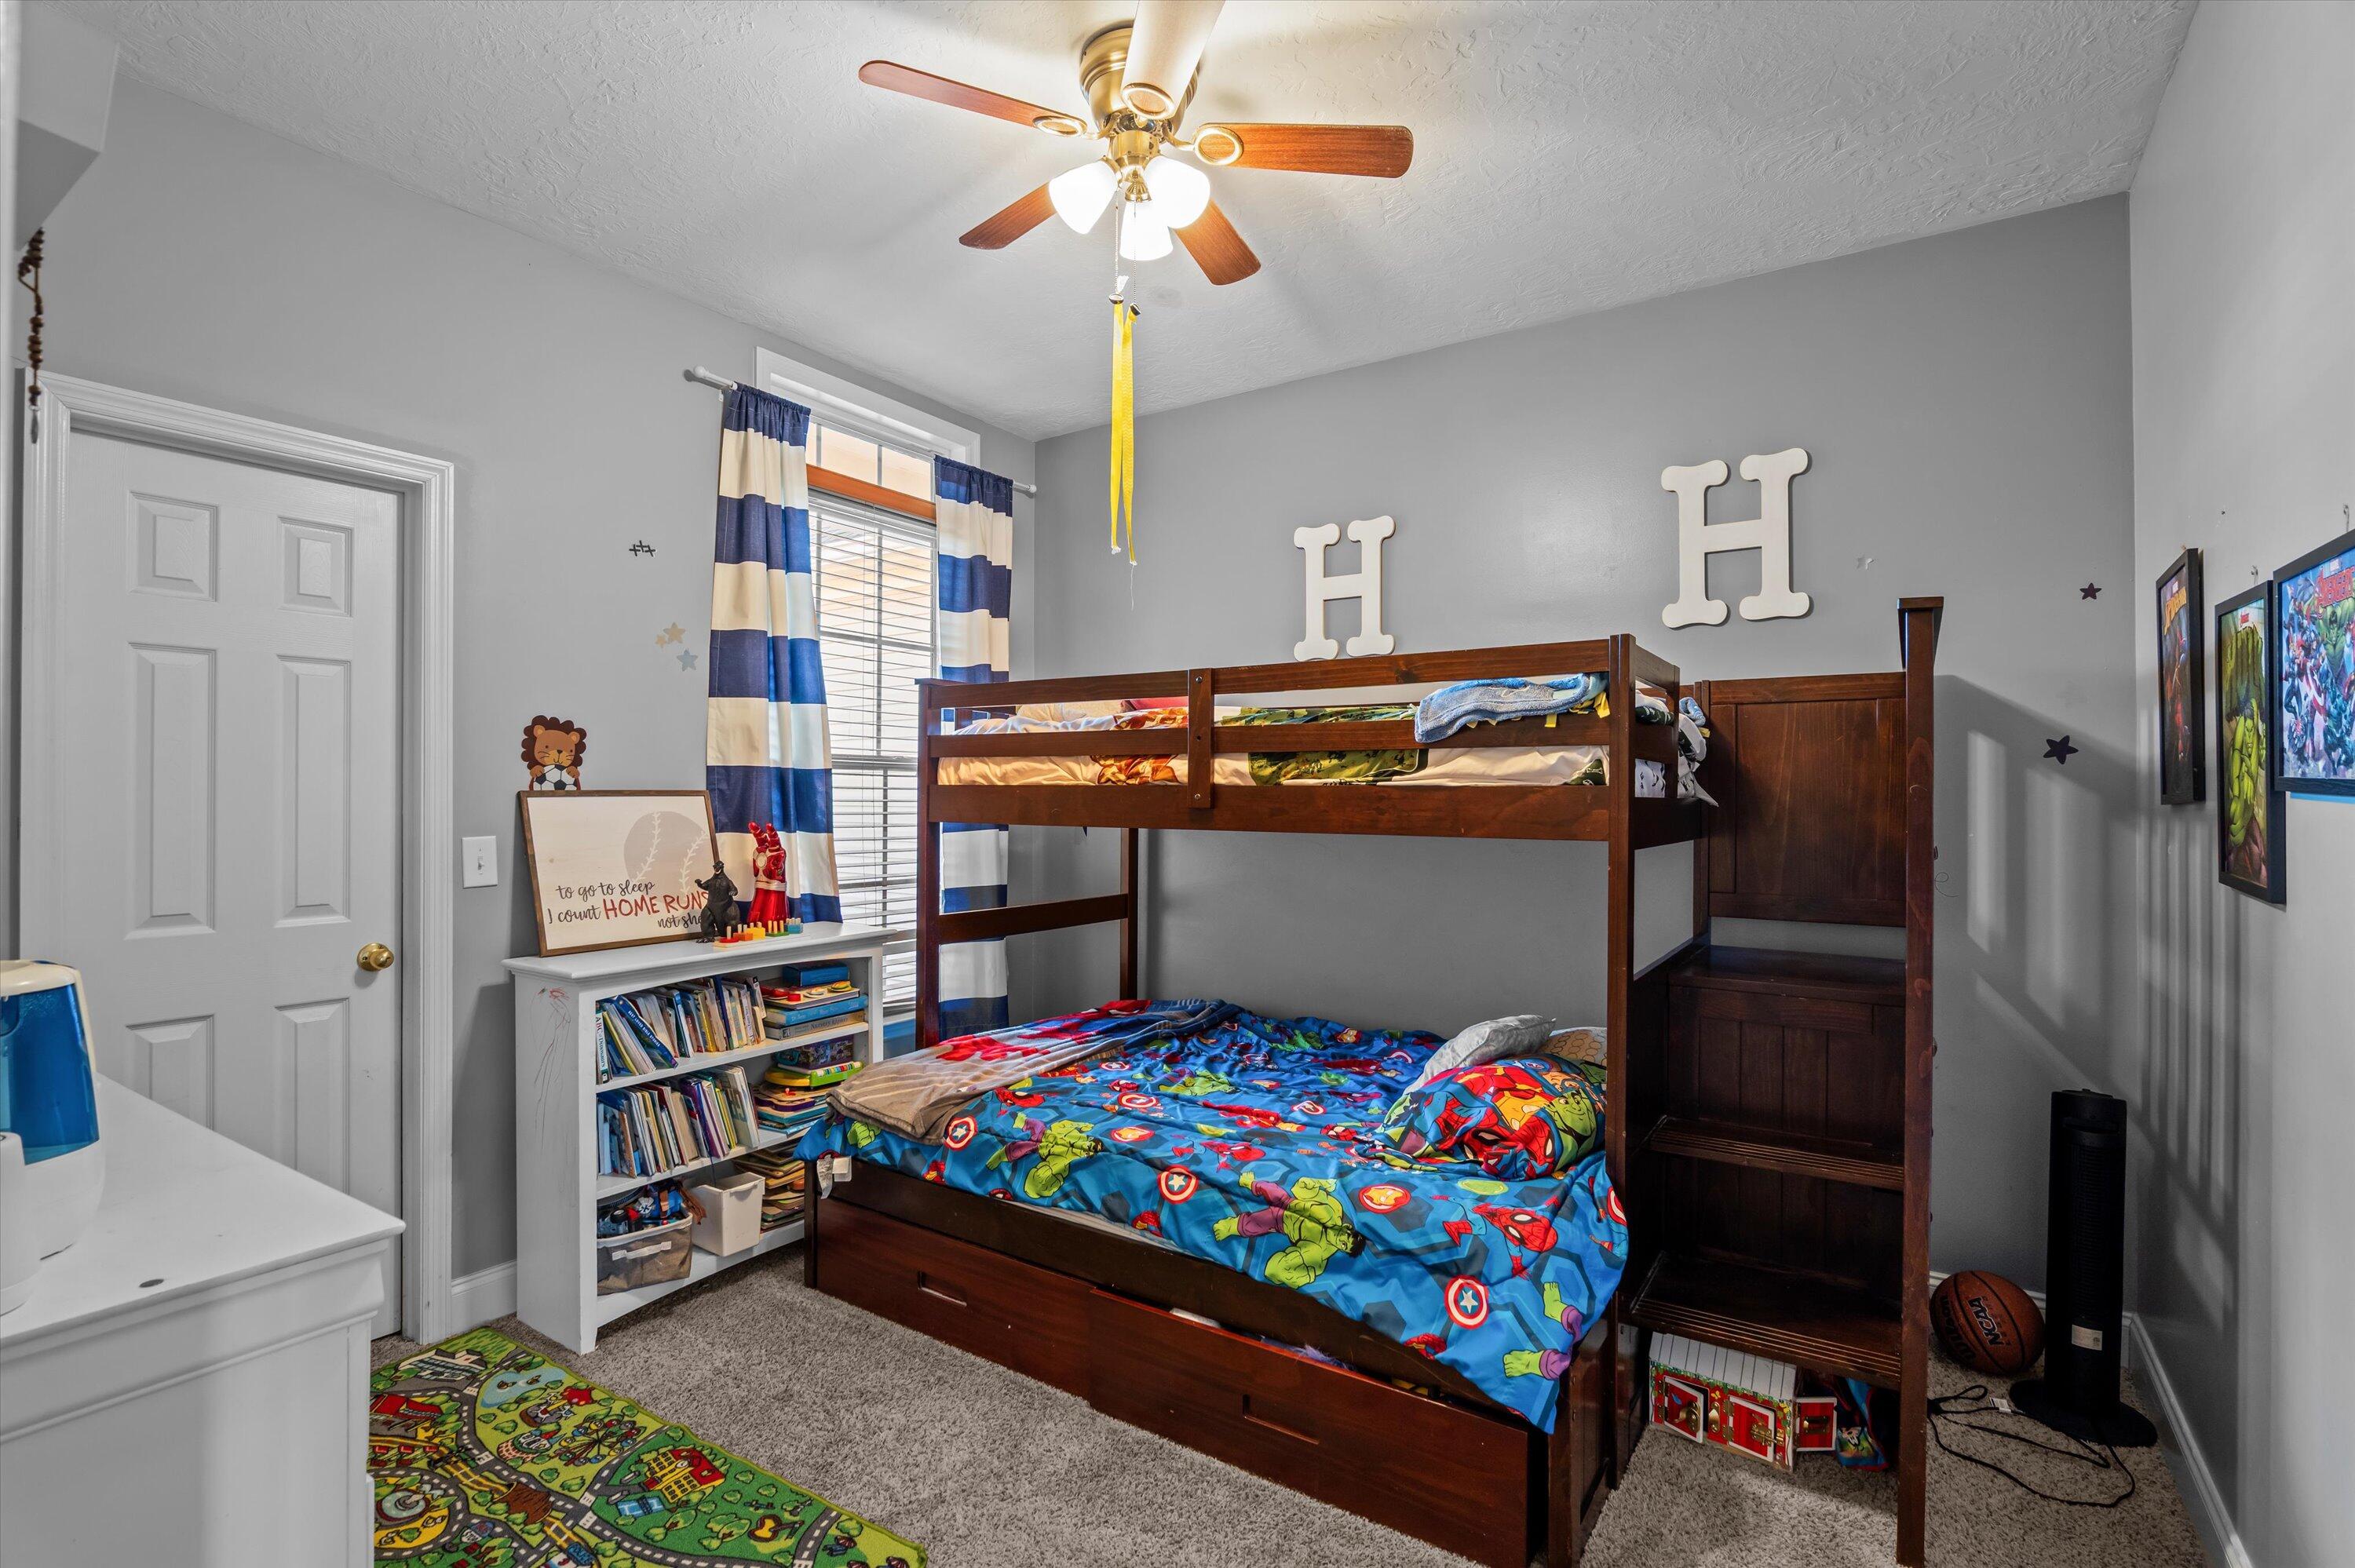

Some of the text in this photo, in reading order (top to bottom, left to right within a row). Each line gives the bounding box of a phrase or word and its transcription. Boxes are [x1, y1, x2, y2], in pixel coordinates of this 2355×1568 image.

[1661, 447, 1810, 628] H
[1294, 515, 1396, 662] H
[556, 879, 655, 902] to go to sleep
[558, 905, 601, 923] count
[603, 895, 660, 920] HOME
[658, 912, 702, 928] not she
[634, 1018, 644, 1028] LOVED
[642, 1026, 651, 1036] BIBLE
[649, 1034, 660, 1047] STORIES
[1967, 1296, 2005, 1345] NCAA
